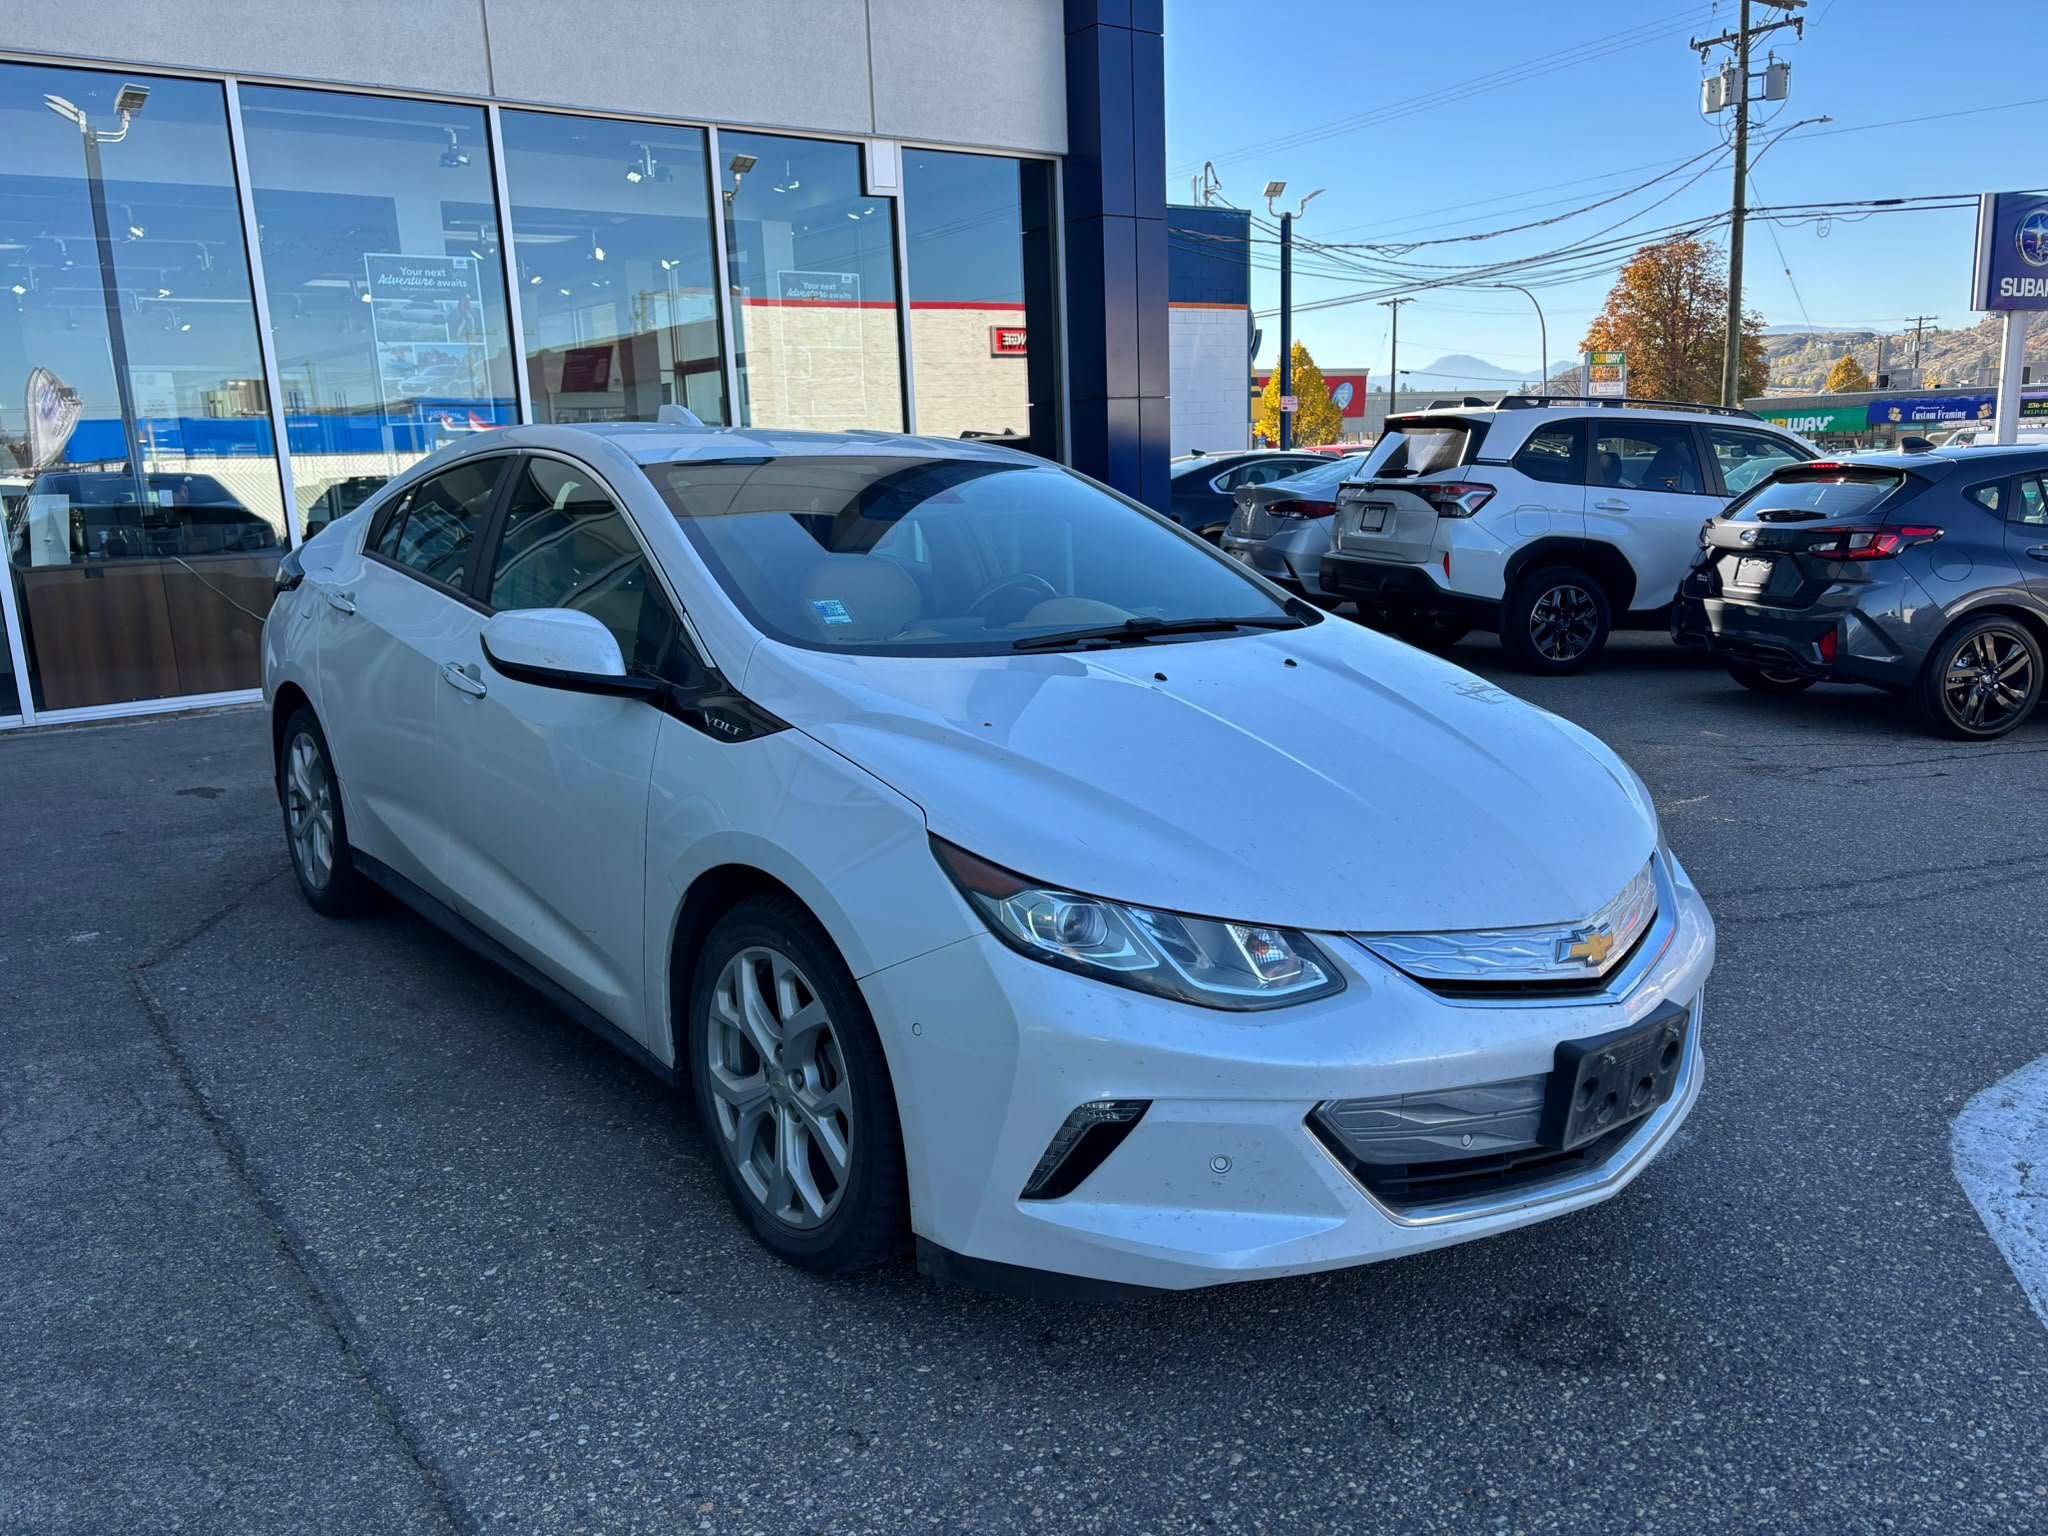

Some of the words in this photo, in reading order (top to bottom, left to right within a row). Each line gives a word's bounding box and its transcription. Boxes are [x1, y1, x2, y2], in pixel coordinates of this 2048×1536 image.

[399, 266, 422, 277] Your
[424, 268, 447, 277] next
[377, 273, 436, 287] Adventure
[436, 278, 467, 288] awaits
[1911, 410, 1937, 420] Custom
[1937, 409, 1968, 420] Framing
